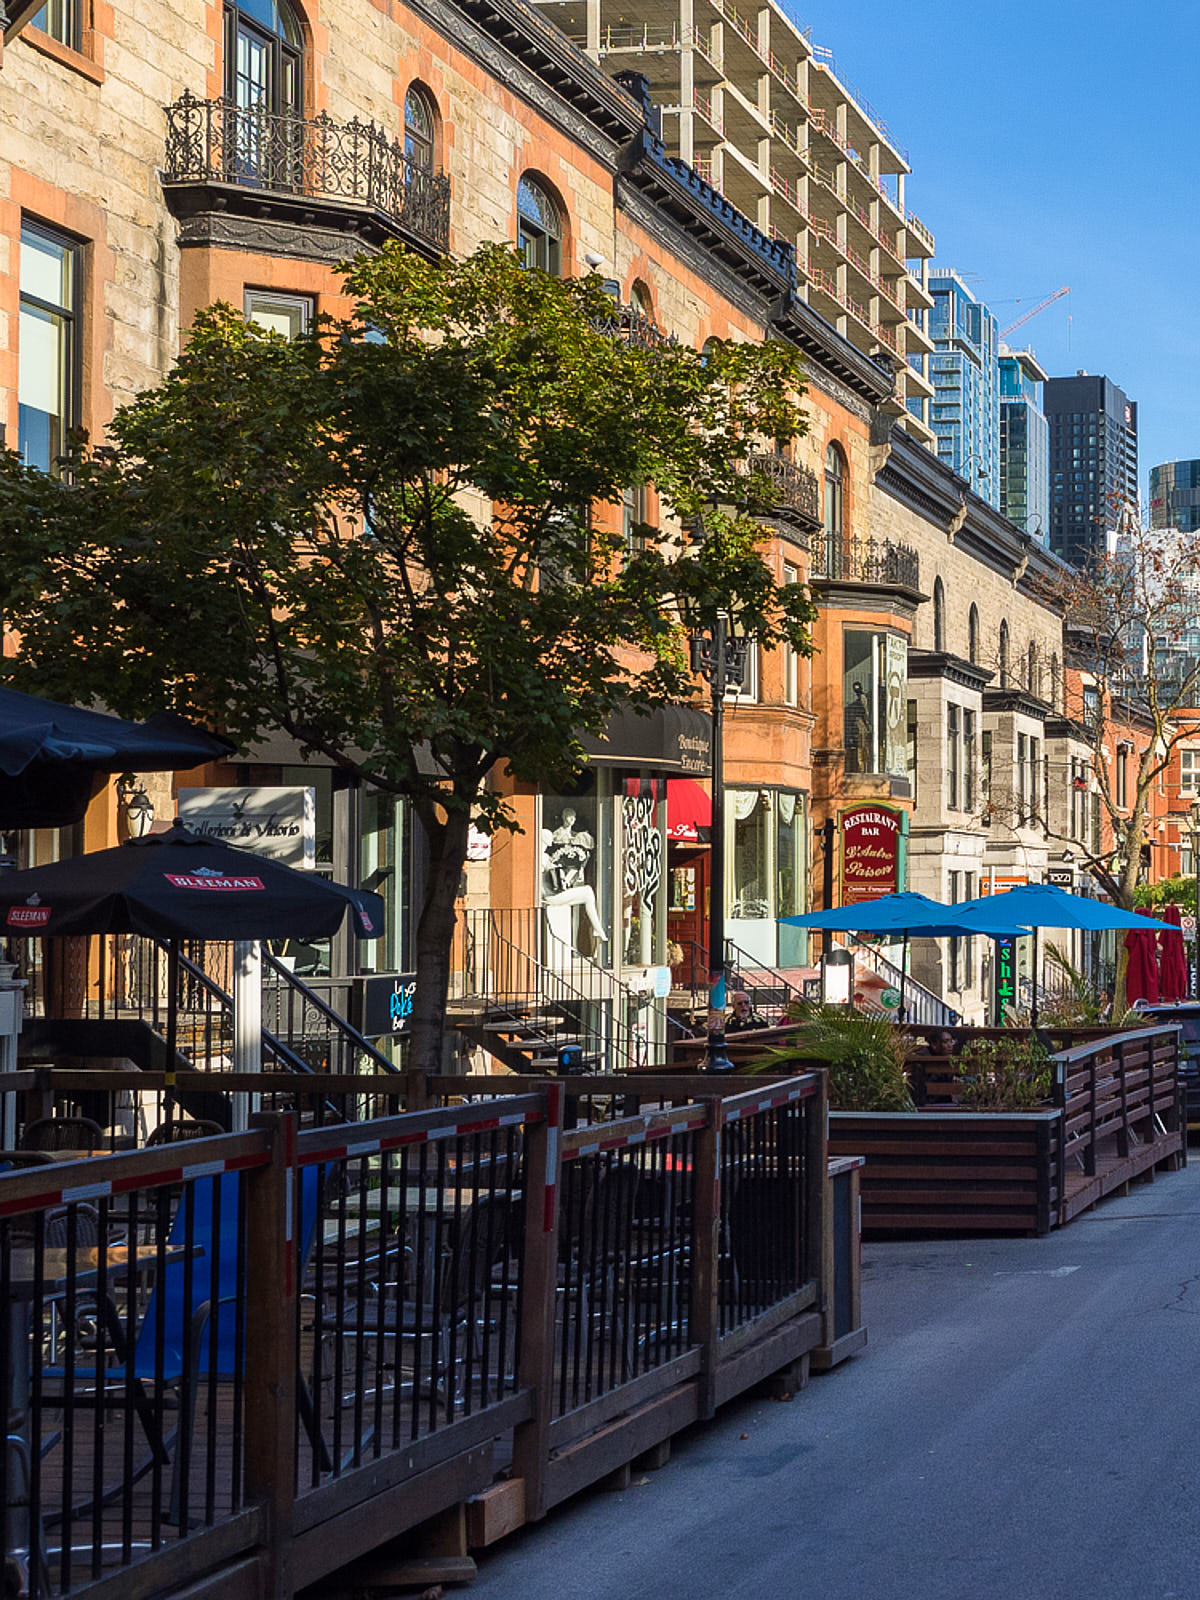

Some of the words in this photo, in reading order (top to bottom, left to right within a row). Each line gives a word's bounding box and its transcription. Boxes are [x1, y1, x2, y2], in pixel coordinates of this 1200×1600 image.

[678, 734, 710, 756] Boutique
[844, 812, 898, 831] RESTAURANT
[861, 827, 880, 836] BAR
[173, 877, 259, 889] SLEEMAN
[10, 910, 49, 921] SLEEMAN
